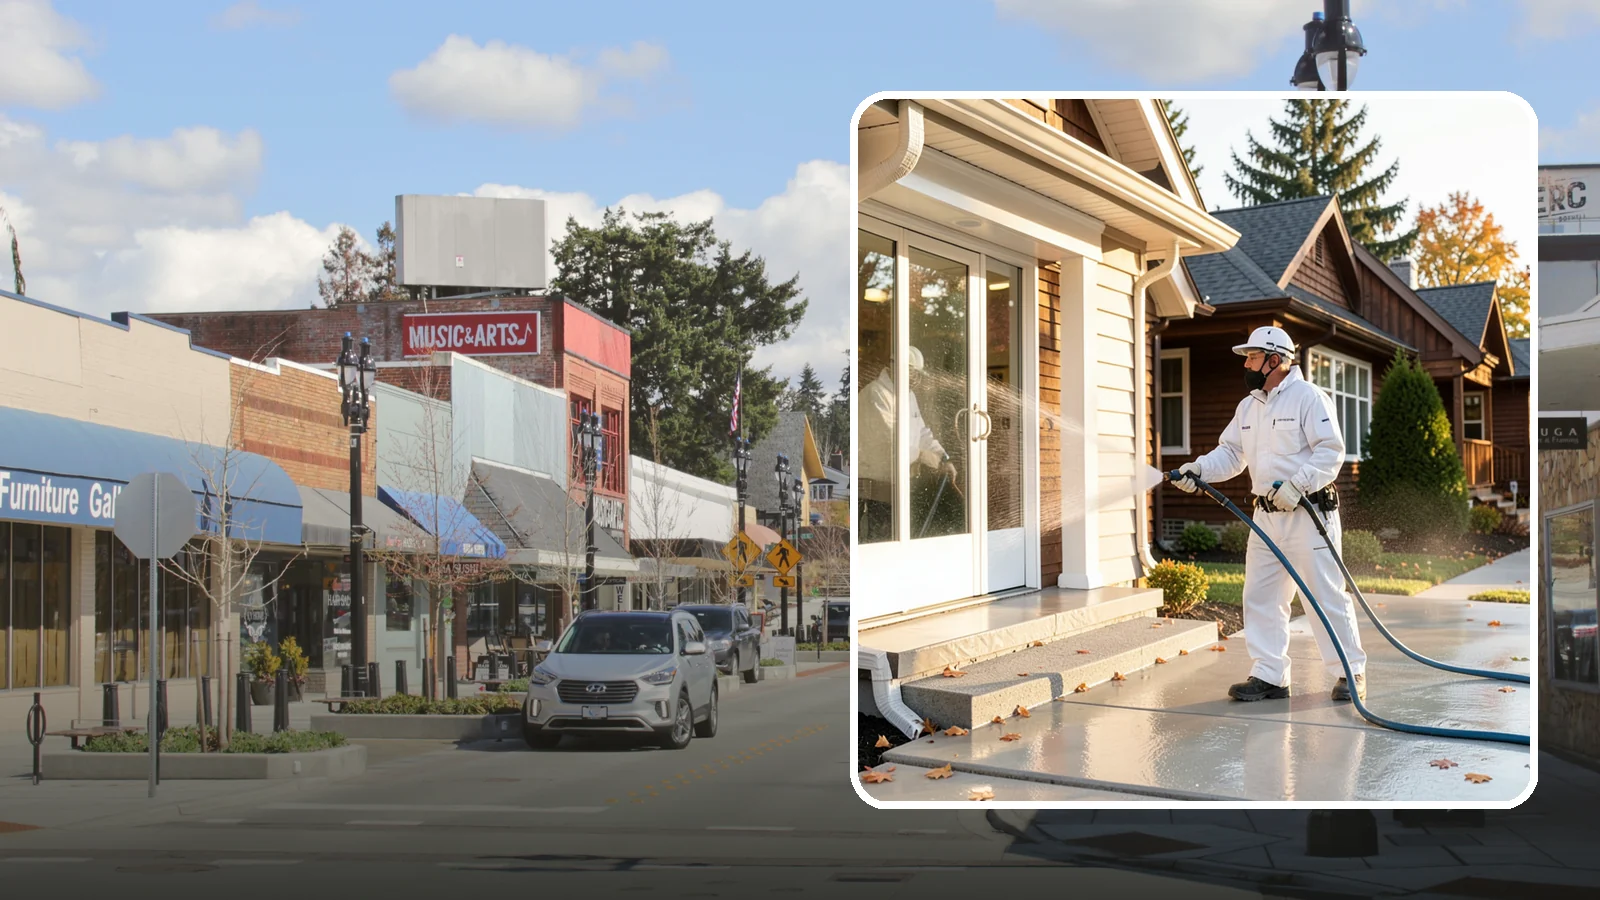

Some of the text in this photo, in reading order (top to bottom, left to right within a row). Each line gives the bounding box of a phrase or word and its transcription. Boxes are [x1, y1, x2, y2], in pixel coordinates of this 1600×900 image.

[1540, 427, 1577, 436] UGA
[0, 471, 122, 519] Furniture Gal
